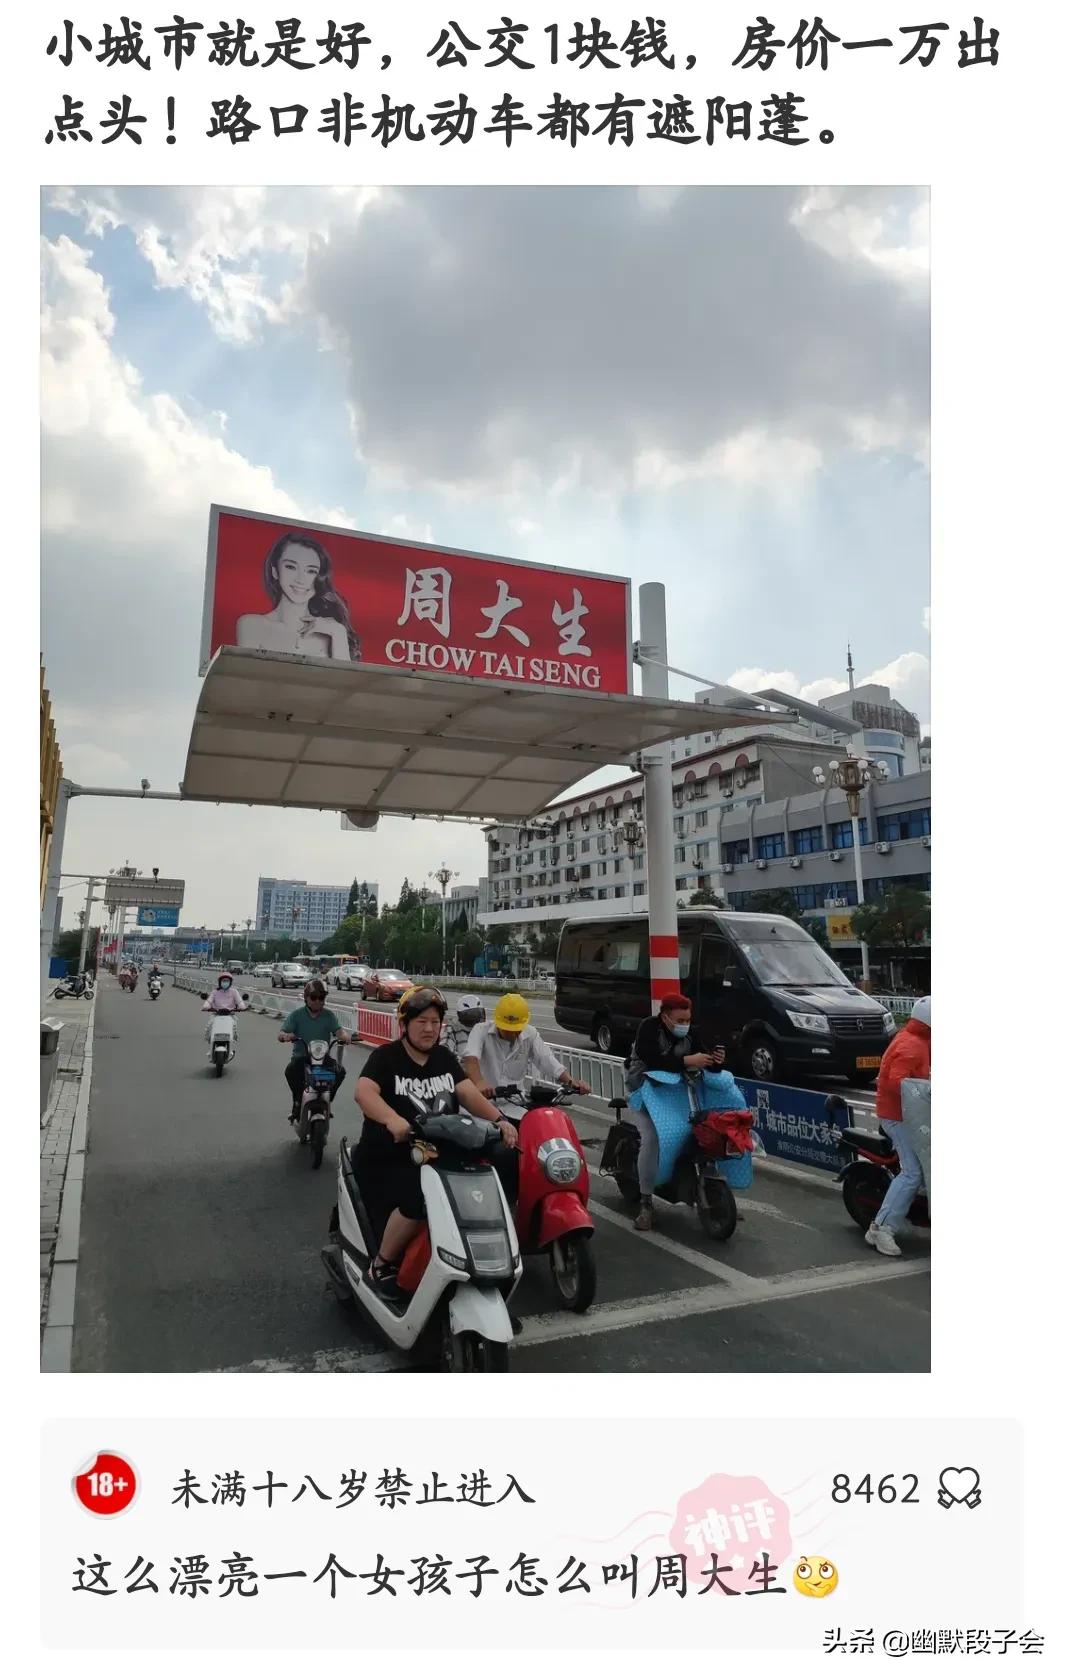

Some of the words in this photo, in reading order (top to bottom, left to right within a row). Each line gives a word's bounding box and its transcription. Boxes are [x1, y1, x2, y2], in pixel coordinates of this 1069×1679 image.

[397, 566, 592, 657] 周大生
[385, 638, 476, 672] CHOW
[480, 651, 526, 679] TAI
[529, 658, 601, 688] SENG
[394, 1072, 455, 1099] MOSCHINO
